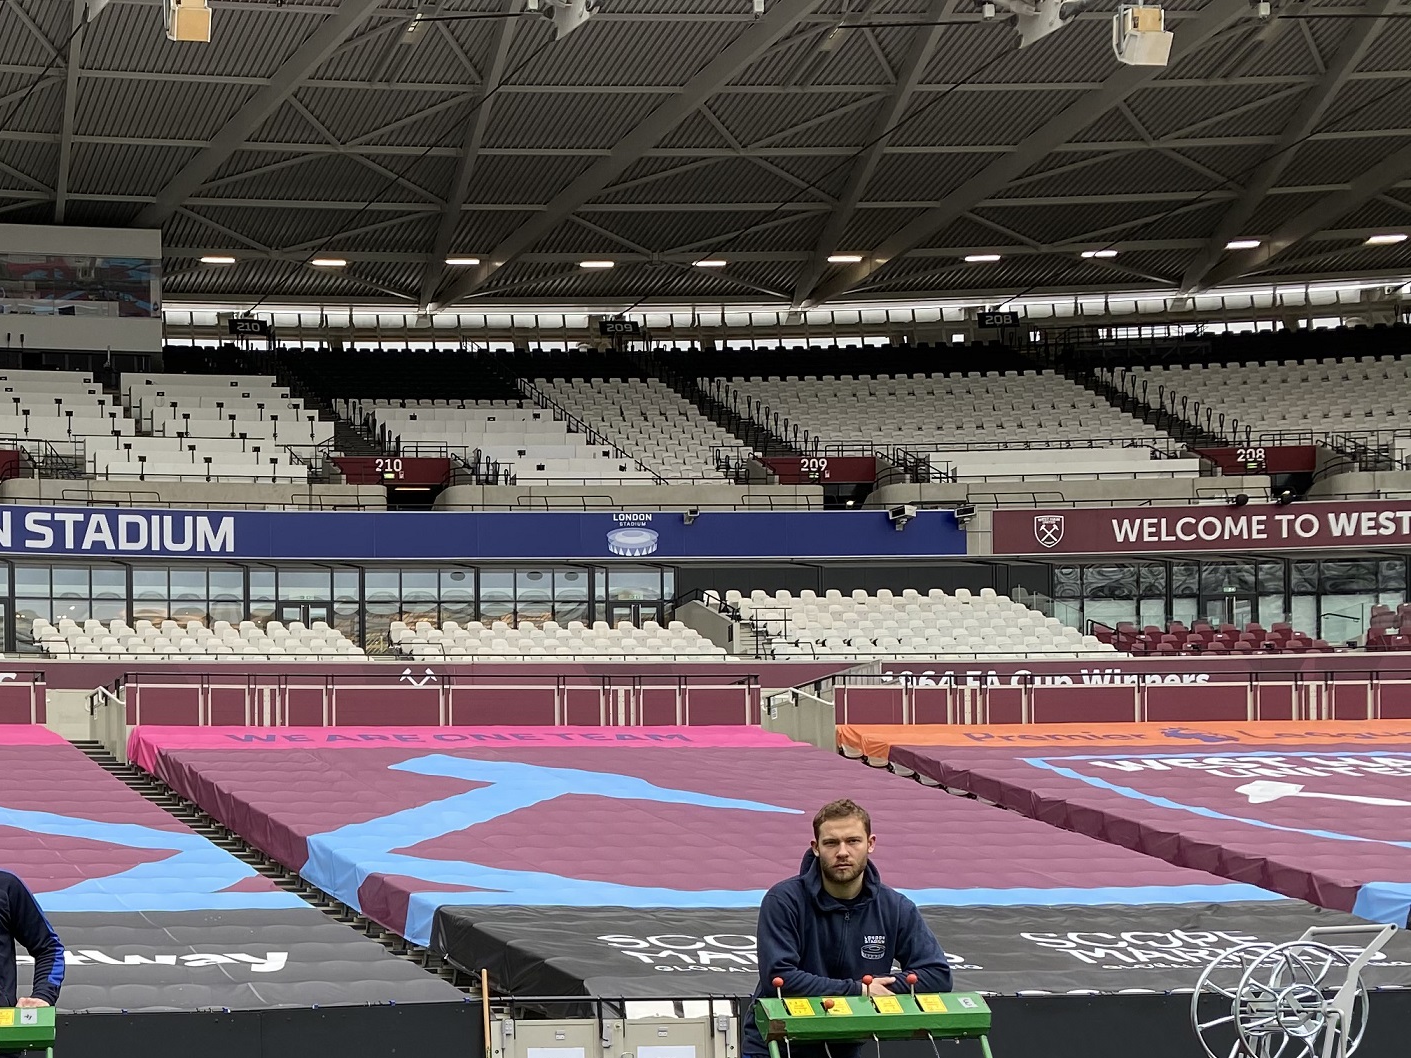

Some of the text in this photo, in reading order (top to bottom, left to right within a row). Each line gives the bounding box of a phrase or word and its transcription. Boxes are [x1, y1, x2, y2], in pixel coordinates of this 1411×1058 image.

[984, 314, 1013, 325] 208
[236, 322, 261, 332] 210
[606, 323, 633, 332] 209
[1237, 448, 1265, 462] 208
[375, 458, 402, 472] 210
[800, 458, 828, 472] 209
[612, 513, 653, 522] LONDON
[24, 510, 235, 552] STADIUM
[1111, 510, 1411, 543] WELCOME TO WEST
[966, 670, 1001, 686] FA
[225, 732, 692, 743] WE ARE ONE TEAM
[963, 731, 1148, 743] Premier
[1088, 756, 1298, 772] WEST
[1020, 929, 1261, 949] SCOPE
